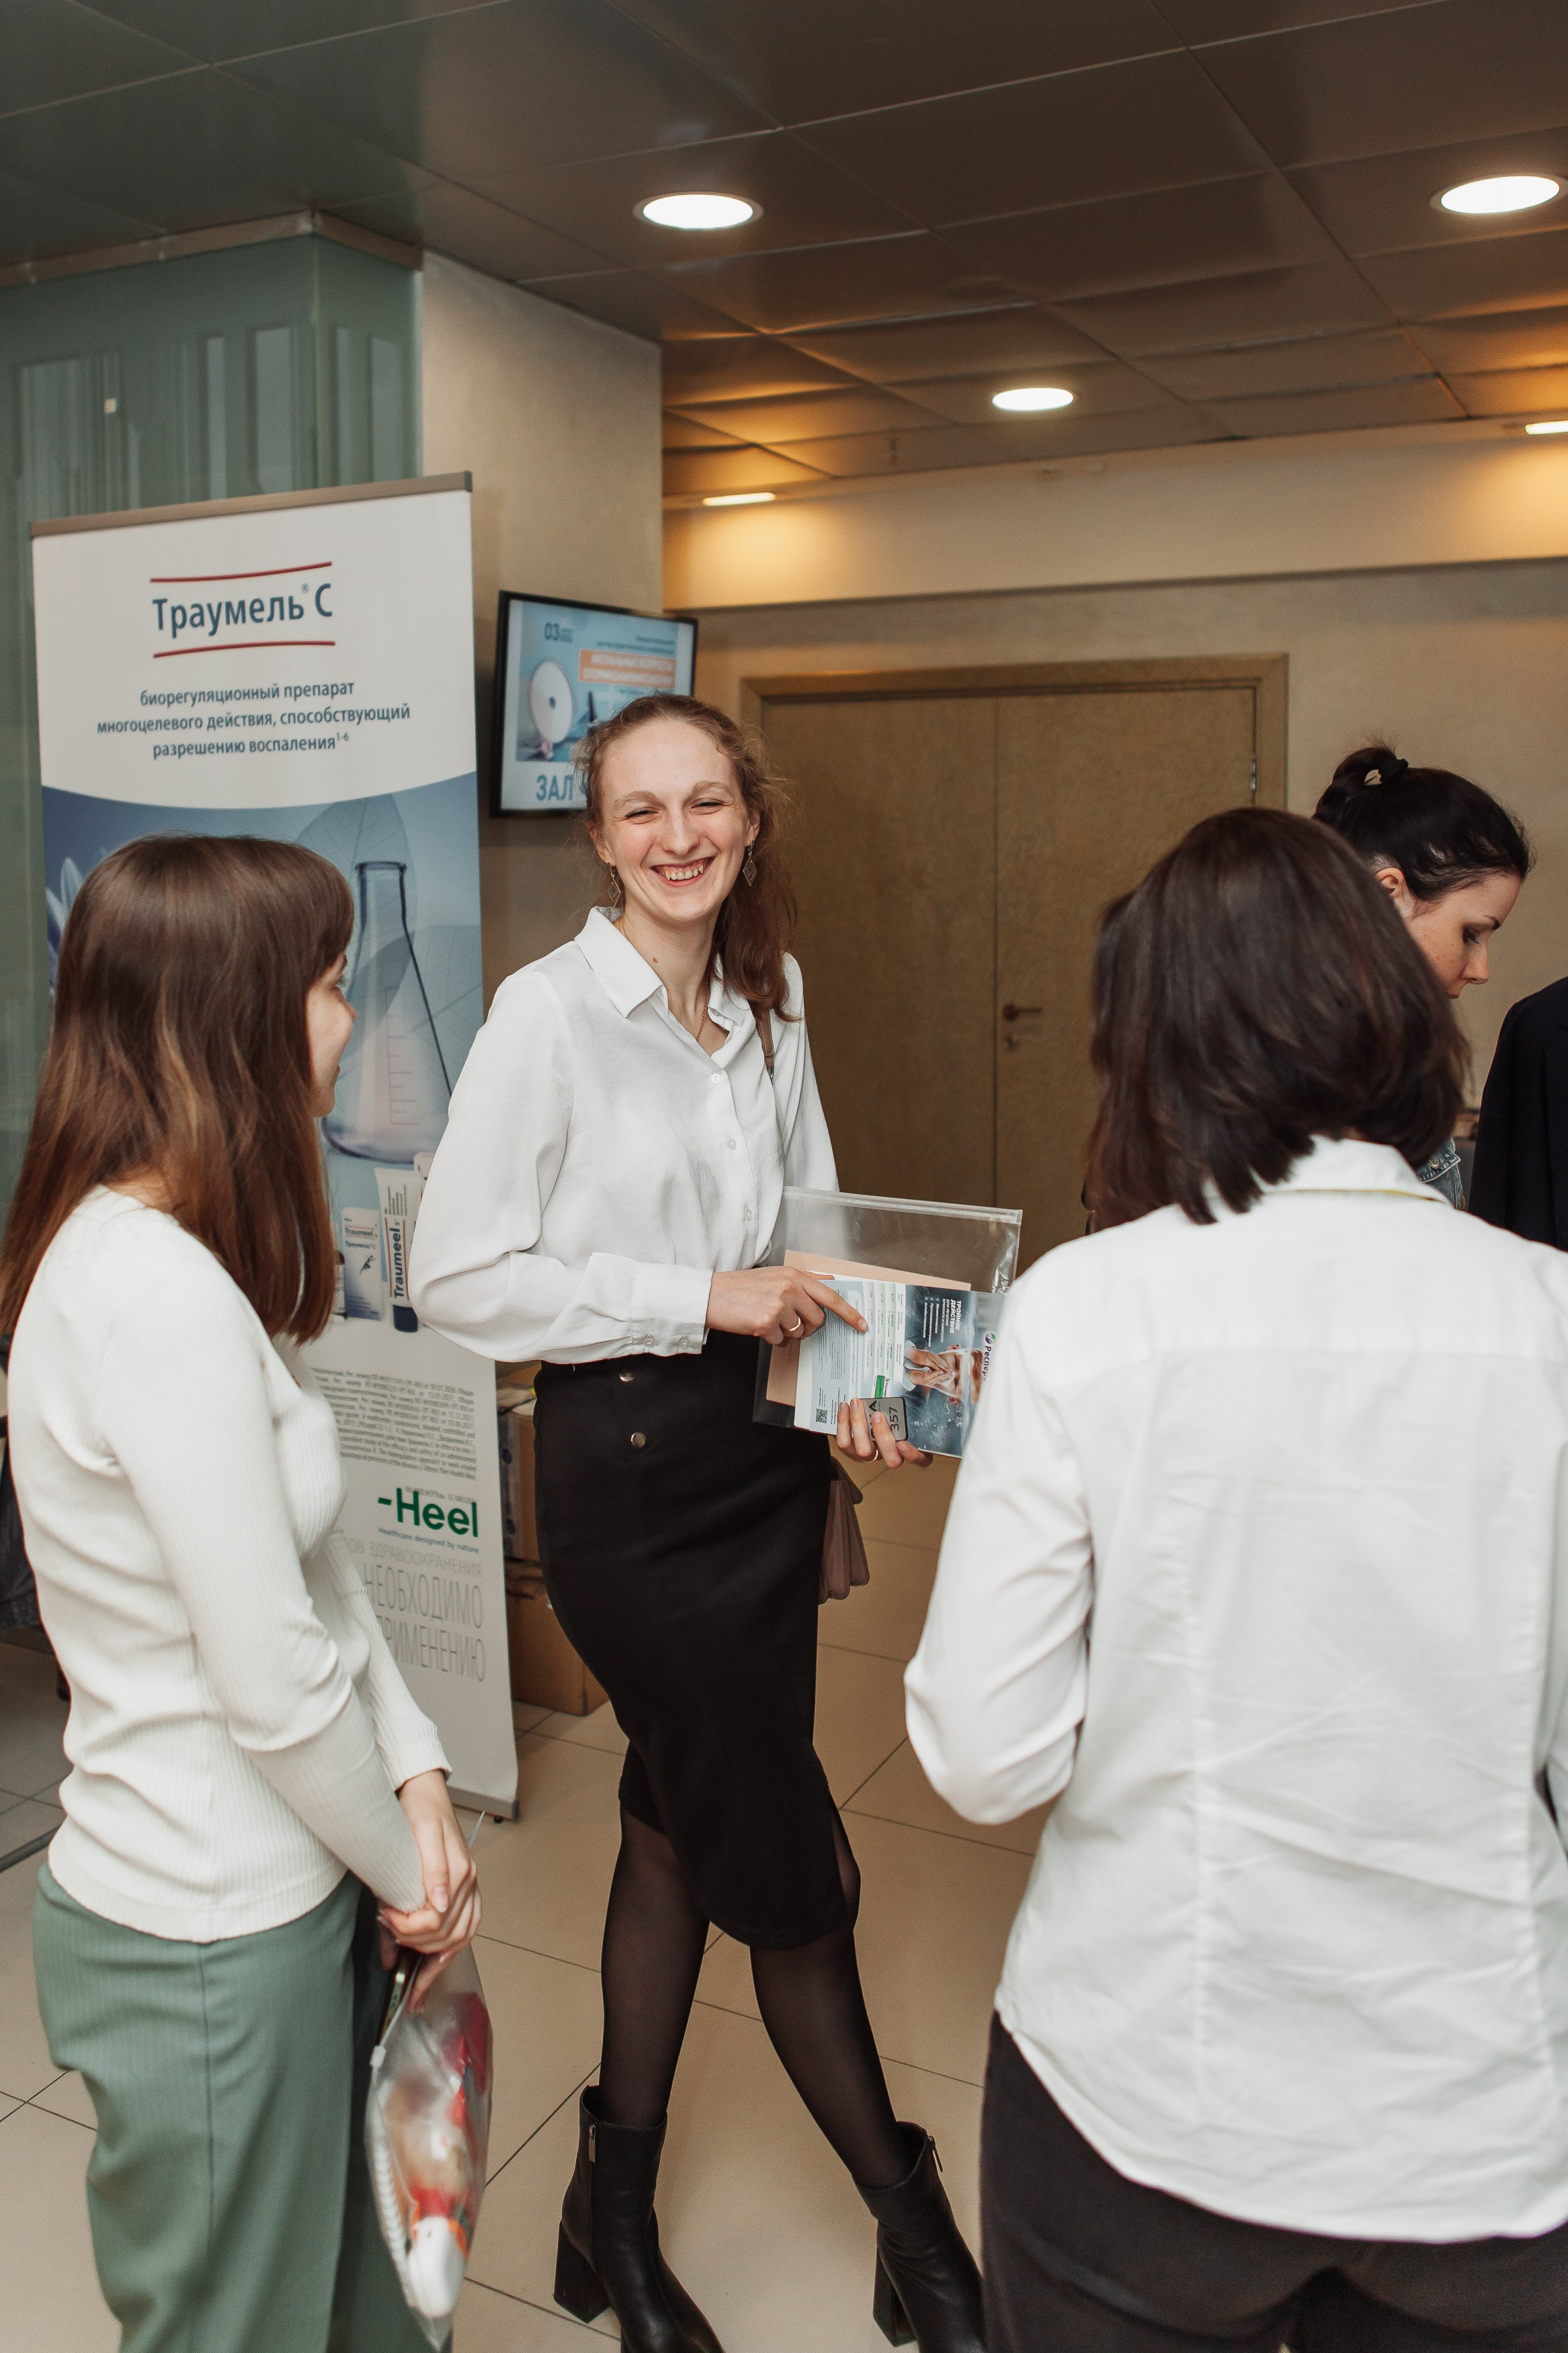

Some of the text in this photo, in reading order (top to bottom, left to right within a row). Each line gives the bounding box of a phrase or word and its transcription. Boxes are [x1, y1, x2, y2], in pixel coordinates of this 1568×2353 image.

[544, 623, 559, 640] 03
[140, 682, 355, 709] биорегуляционный препарат
[97, 703, 411, 734] многоцелевого действия, способствующий
[153, 741, 246, 761] разрешению
[536, 774, 573, 801] ЗАЛ
[390, 1227, 405, 1299] Traumeel
[889, 1407, 899, 1431] 357
[415, 1536, 445, 1546] designed
[446, 1541, 455, 1550] by
